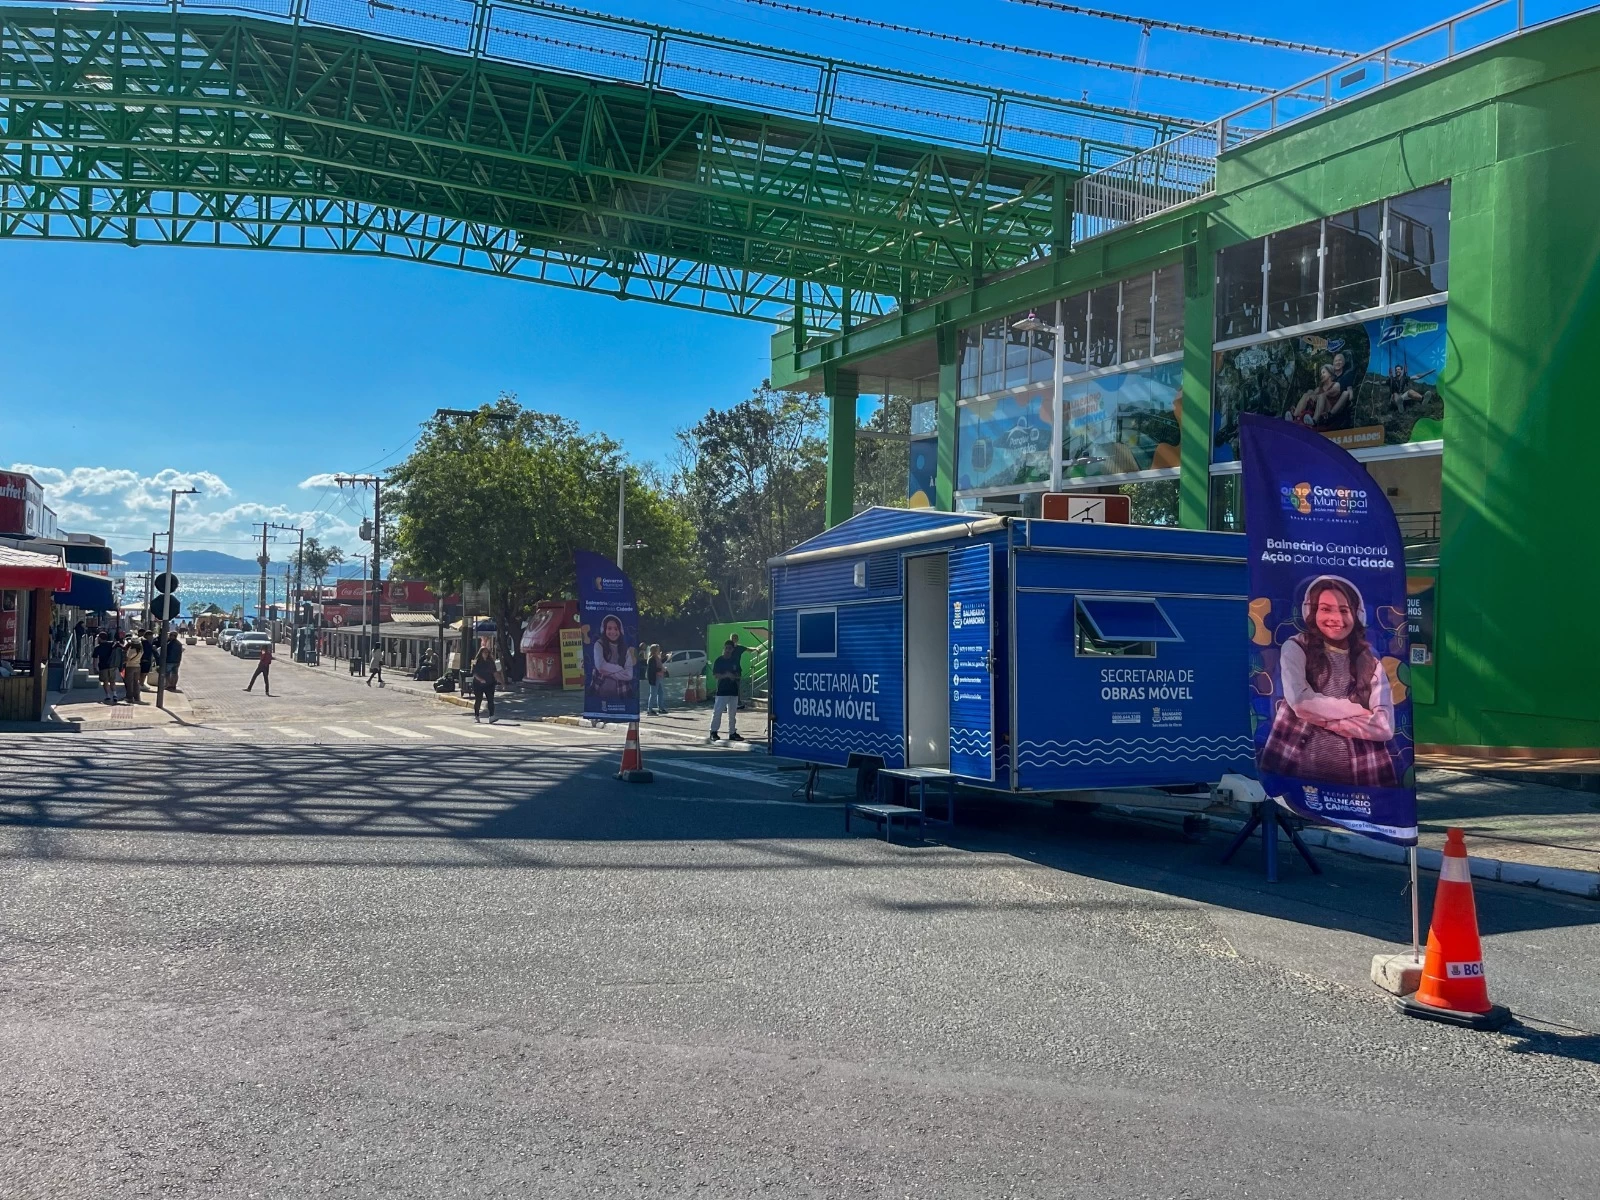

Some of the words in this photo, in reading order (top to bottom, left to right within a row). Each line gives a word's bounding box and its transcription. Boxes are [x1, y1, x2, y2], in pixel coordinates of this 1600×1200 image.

[1313, 485, 1367, 498] Governo
[1313, 496, 1368, 509] Municipal
[1266, 538, 1324, 553] Balneário
[1326, 542, 1388, 556] Camboriú
[1261, 550, 1292, 564] Ação
[1293, 554, 1314, 565] por
[1316, 555, 1345, 566] toda
[1347, 556, 1395, 569] Cidade
[793, 672, 860, 693] SECRETARIA
[862, 673, 880, 694] DE
[1100, 669, 1176, 683] SECRETARIA
[1178, 669, 1195, 683] DE
[1101, 687, 1145, 700] OBRAS
[1148, 683, 1194, 700] MÓVEL
[793, 697, 832, 718] OBRAS
[834, 694, 880, 722] MÓVEL
[1323, 795, 1371, 808] BALNEÁRIO
